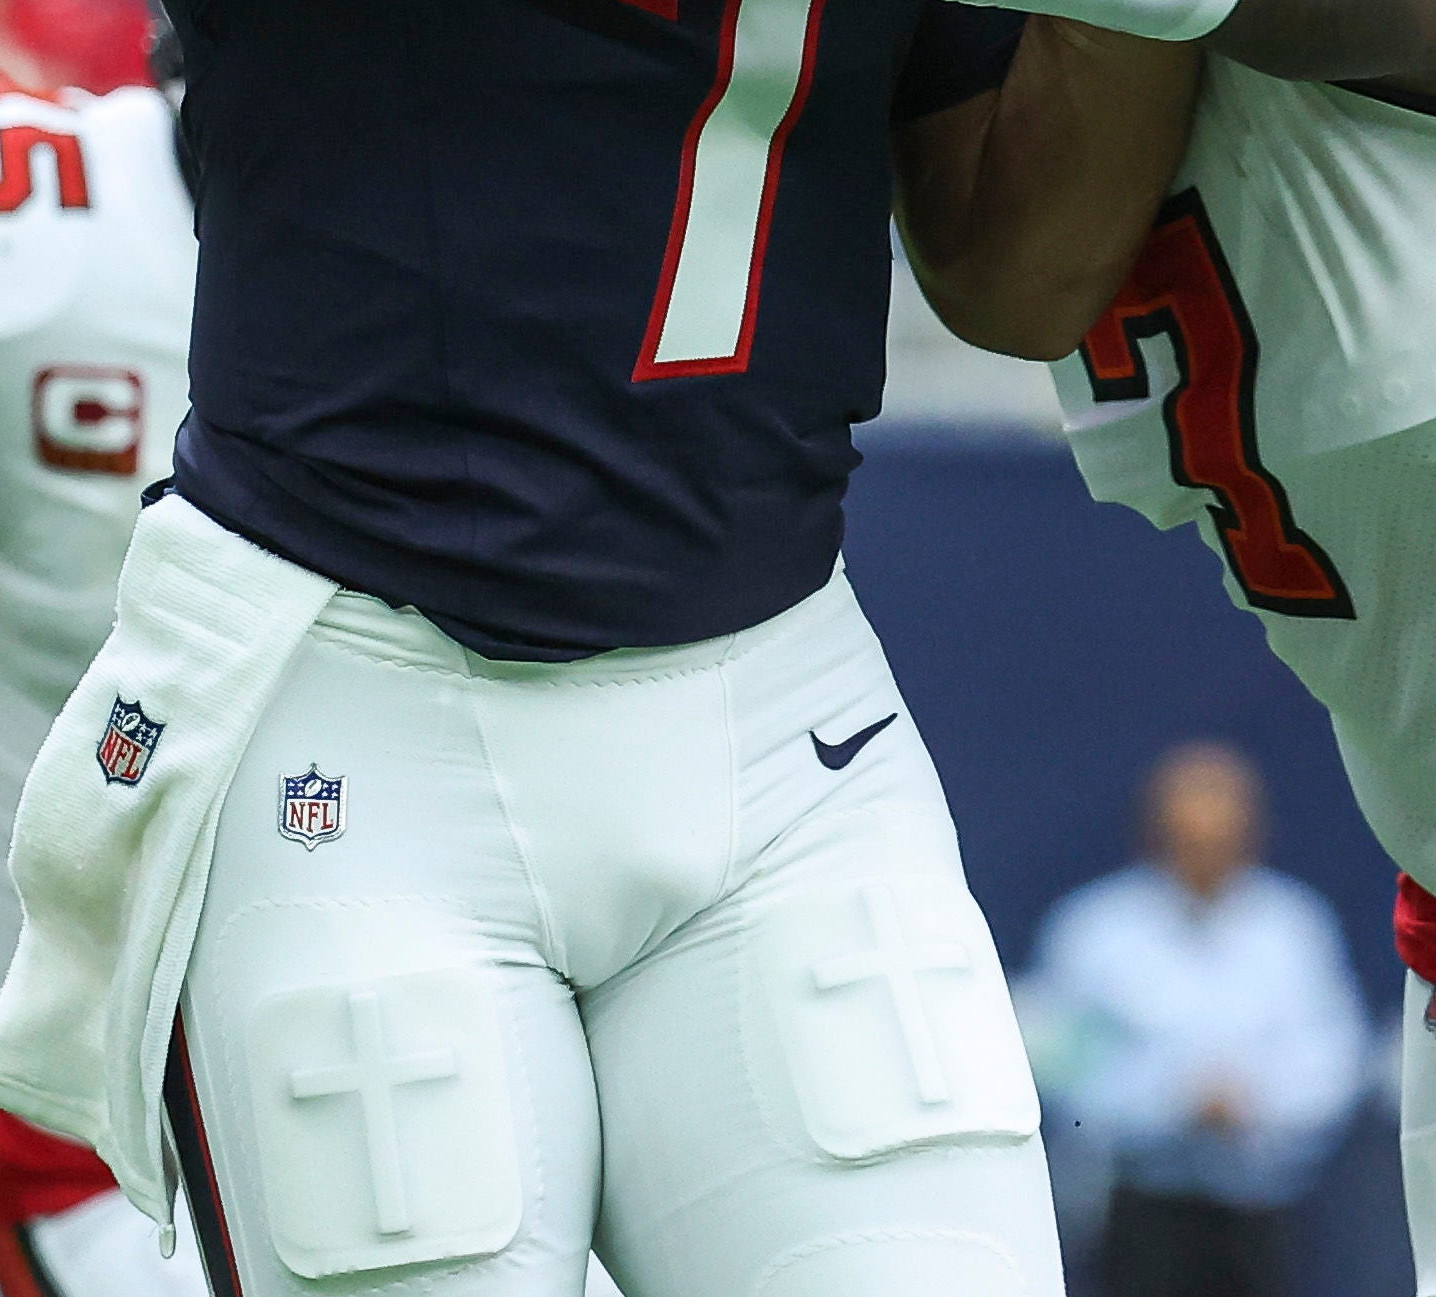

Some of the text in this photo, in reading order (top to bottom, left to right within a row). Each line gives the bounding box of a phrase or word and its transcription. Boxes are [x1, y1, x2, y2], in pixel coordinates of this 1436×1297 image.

[44, 372, 139, 449] C
[1081, 187, 1356, 620] 7
[100, 728, 143, 780] NFL
[289, 802, 334, 832] NFL
